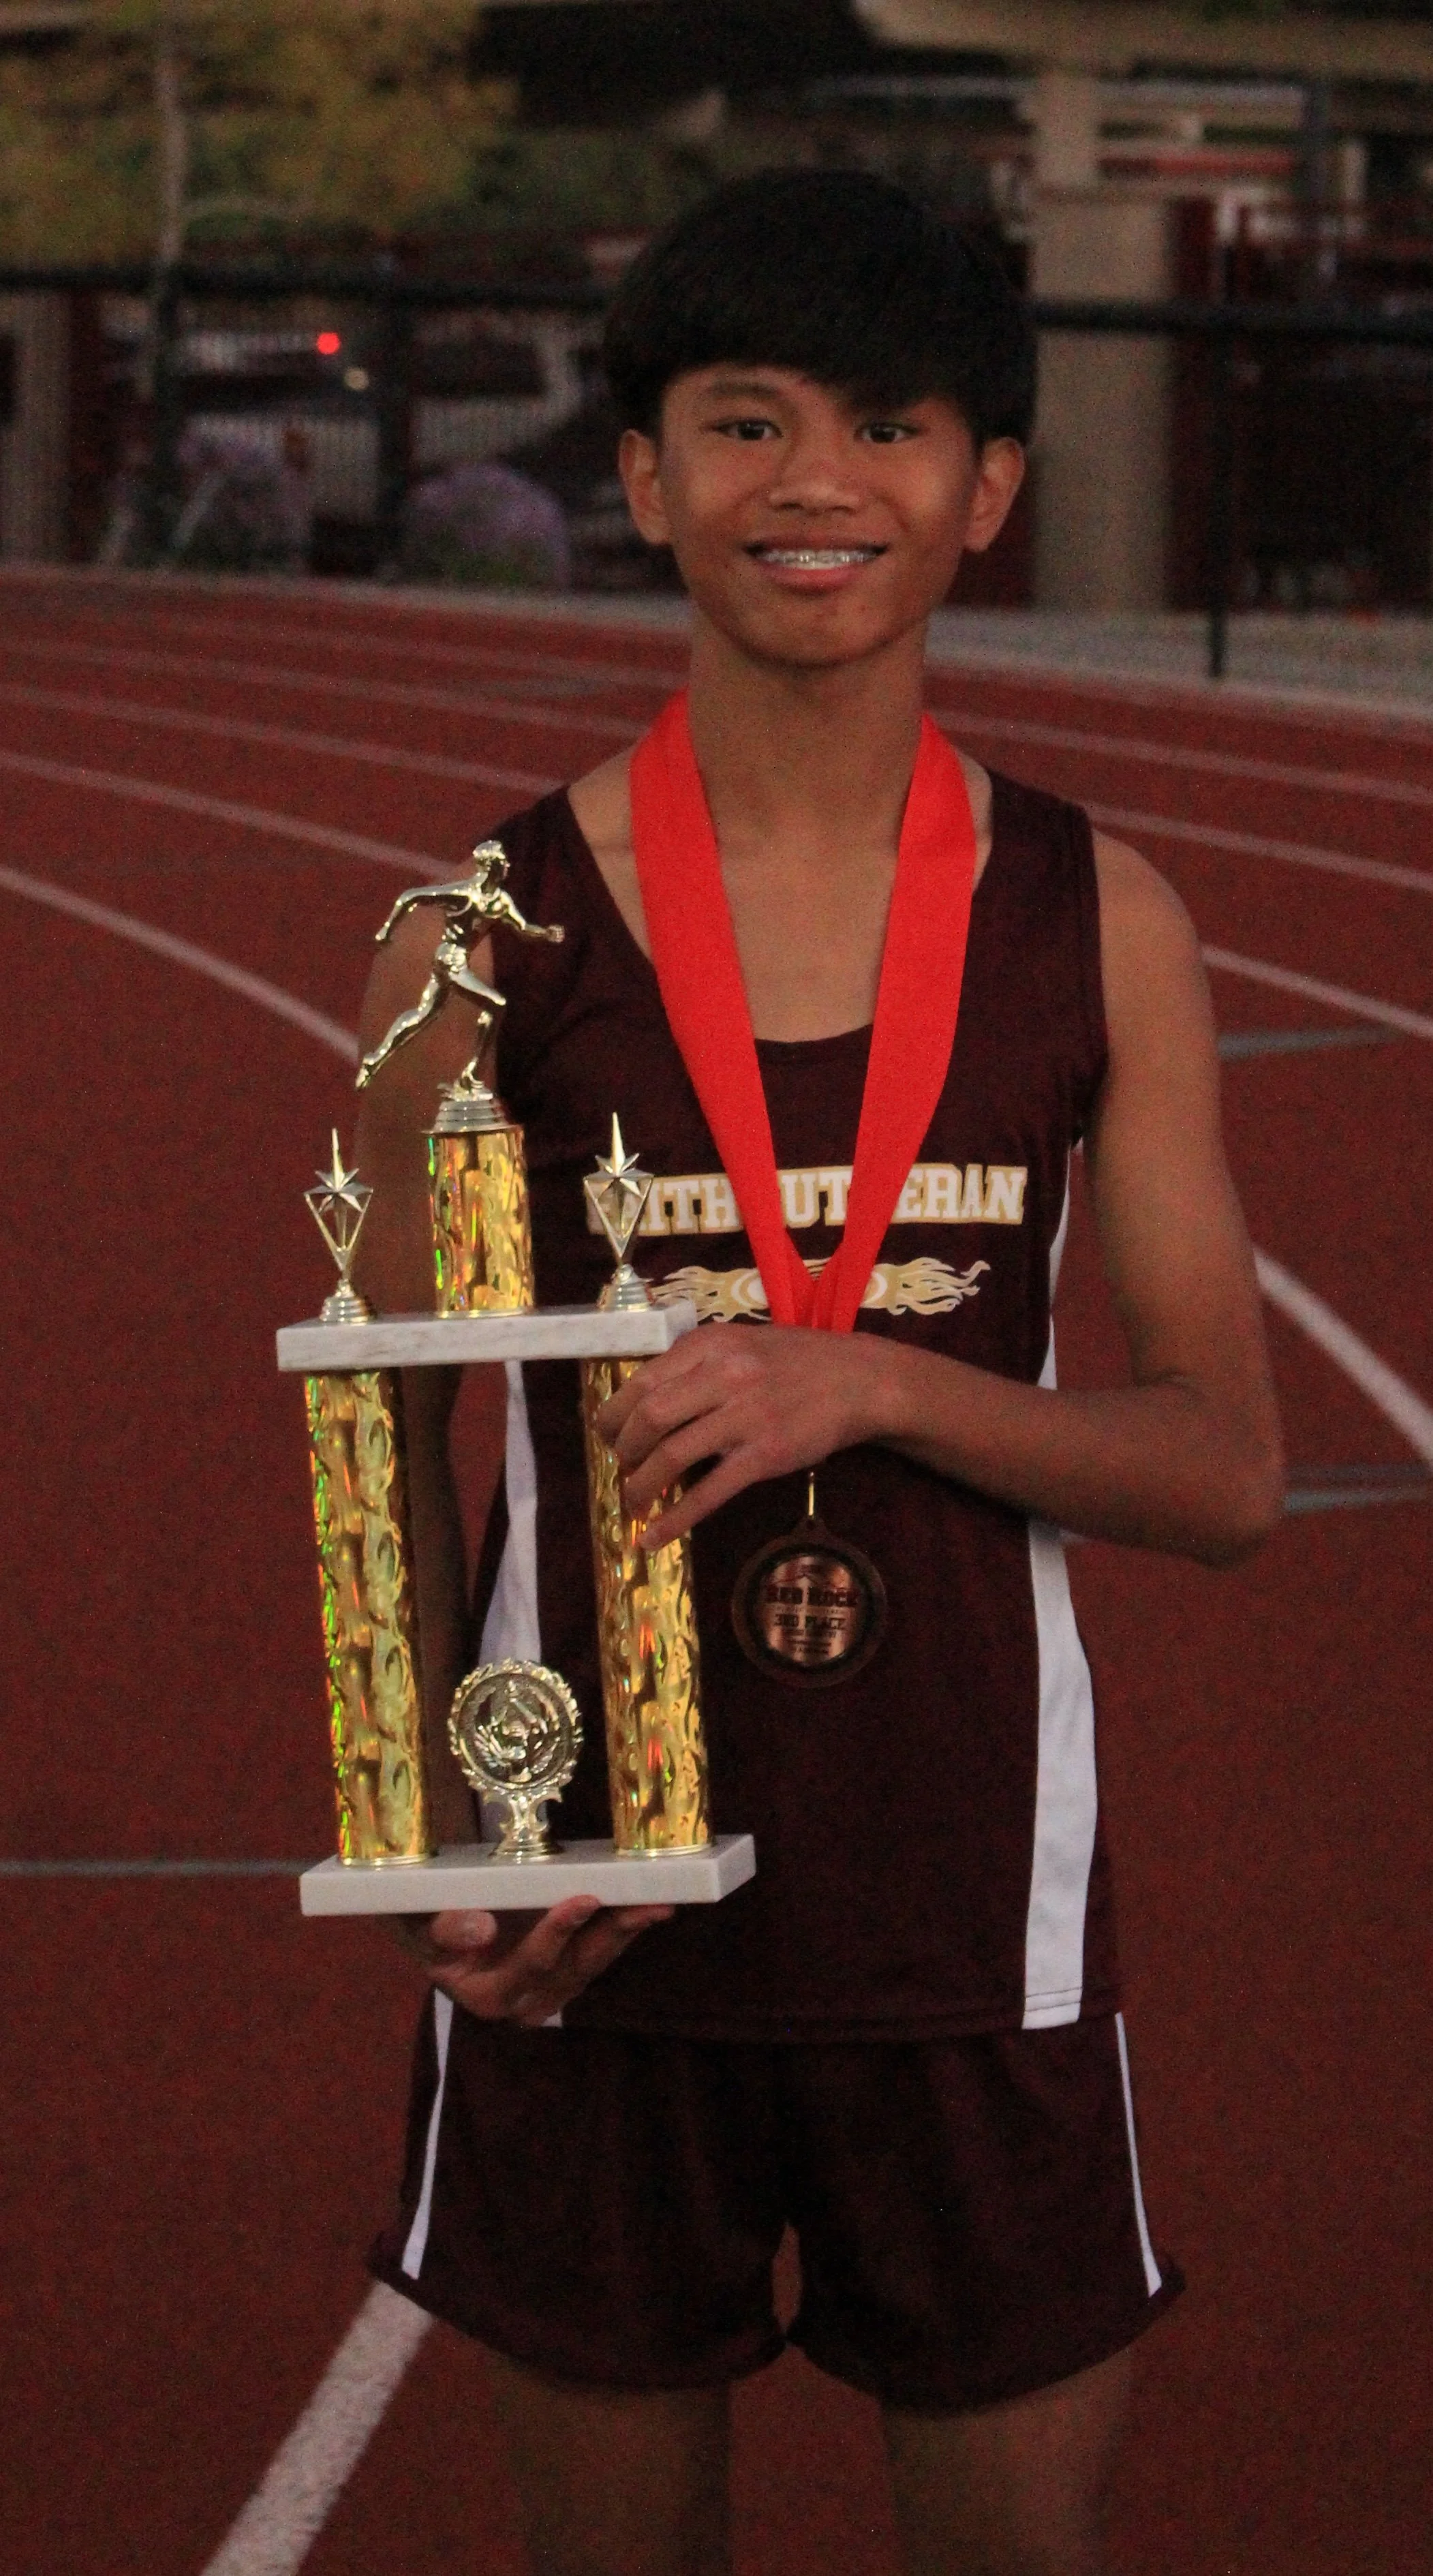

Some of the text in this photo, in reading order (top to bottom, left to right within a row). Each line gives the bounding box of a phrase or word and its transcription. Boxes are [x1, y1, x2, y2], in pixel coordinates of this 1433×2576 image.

[777, 1163, 1027, 1229] UTERAN
[807, 1586, 859, 1606] ROCK
[805, 1615, 846, 1629] PLACE
